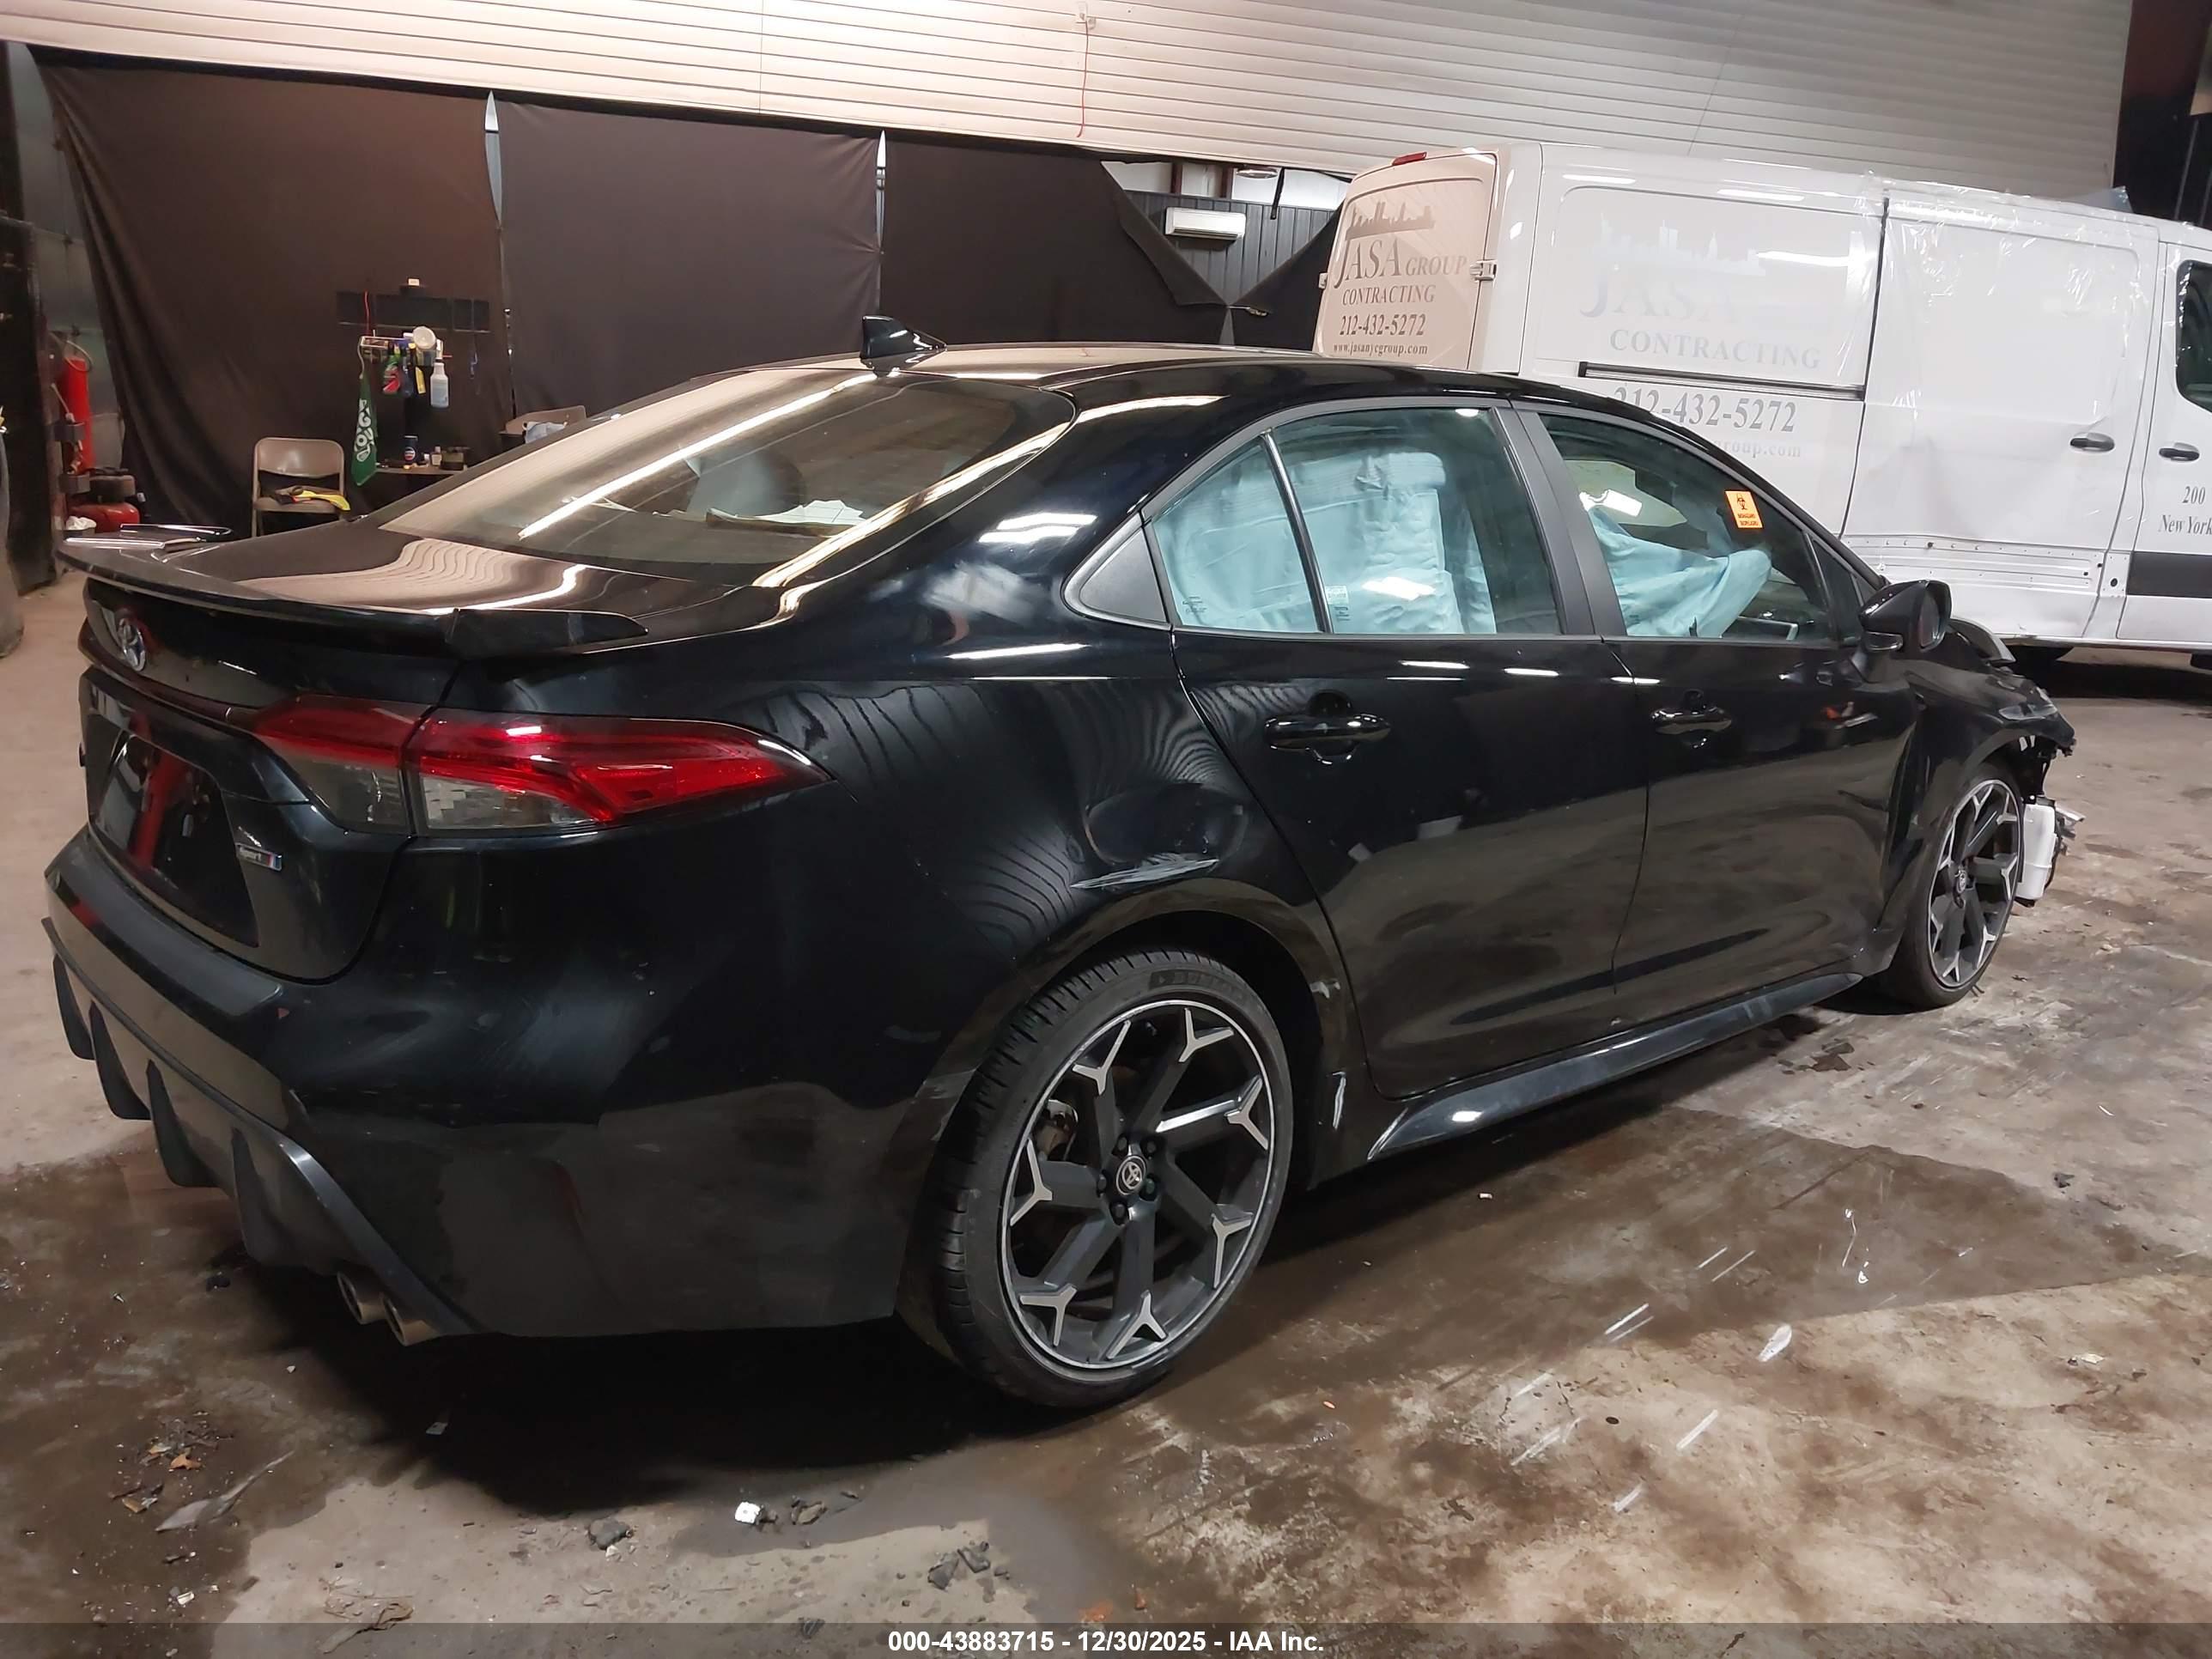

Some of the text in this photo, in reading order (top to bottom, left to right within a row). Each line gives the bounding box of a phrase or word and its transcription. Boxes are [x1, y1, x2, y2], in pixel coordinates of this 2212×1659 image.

[1334, 238, 1468, 289] JASA GROUP
[1342, 285, 1435, 305] CONTRACTING
[1340, 313, 1426, 336] 212-432-5272
[1334, 341, 1428, 357] www.jasanycgroup.com
[1609, 328, 1821, 370] CONTRACTING
[2181, 485, 2206, 505] 200
[2158, 514, 2186, 533] New
